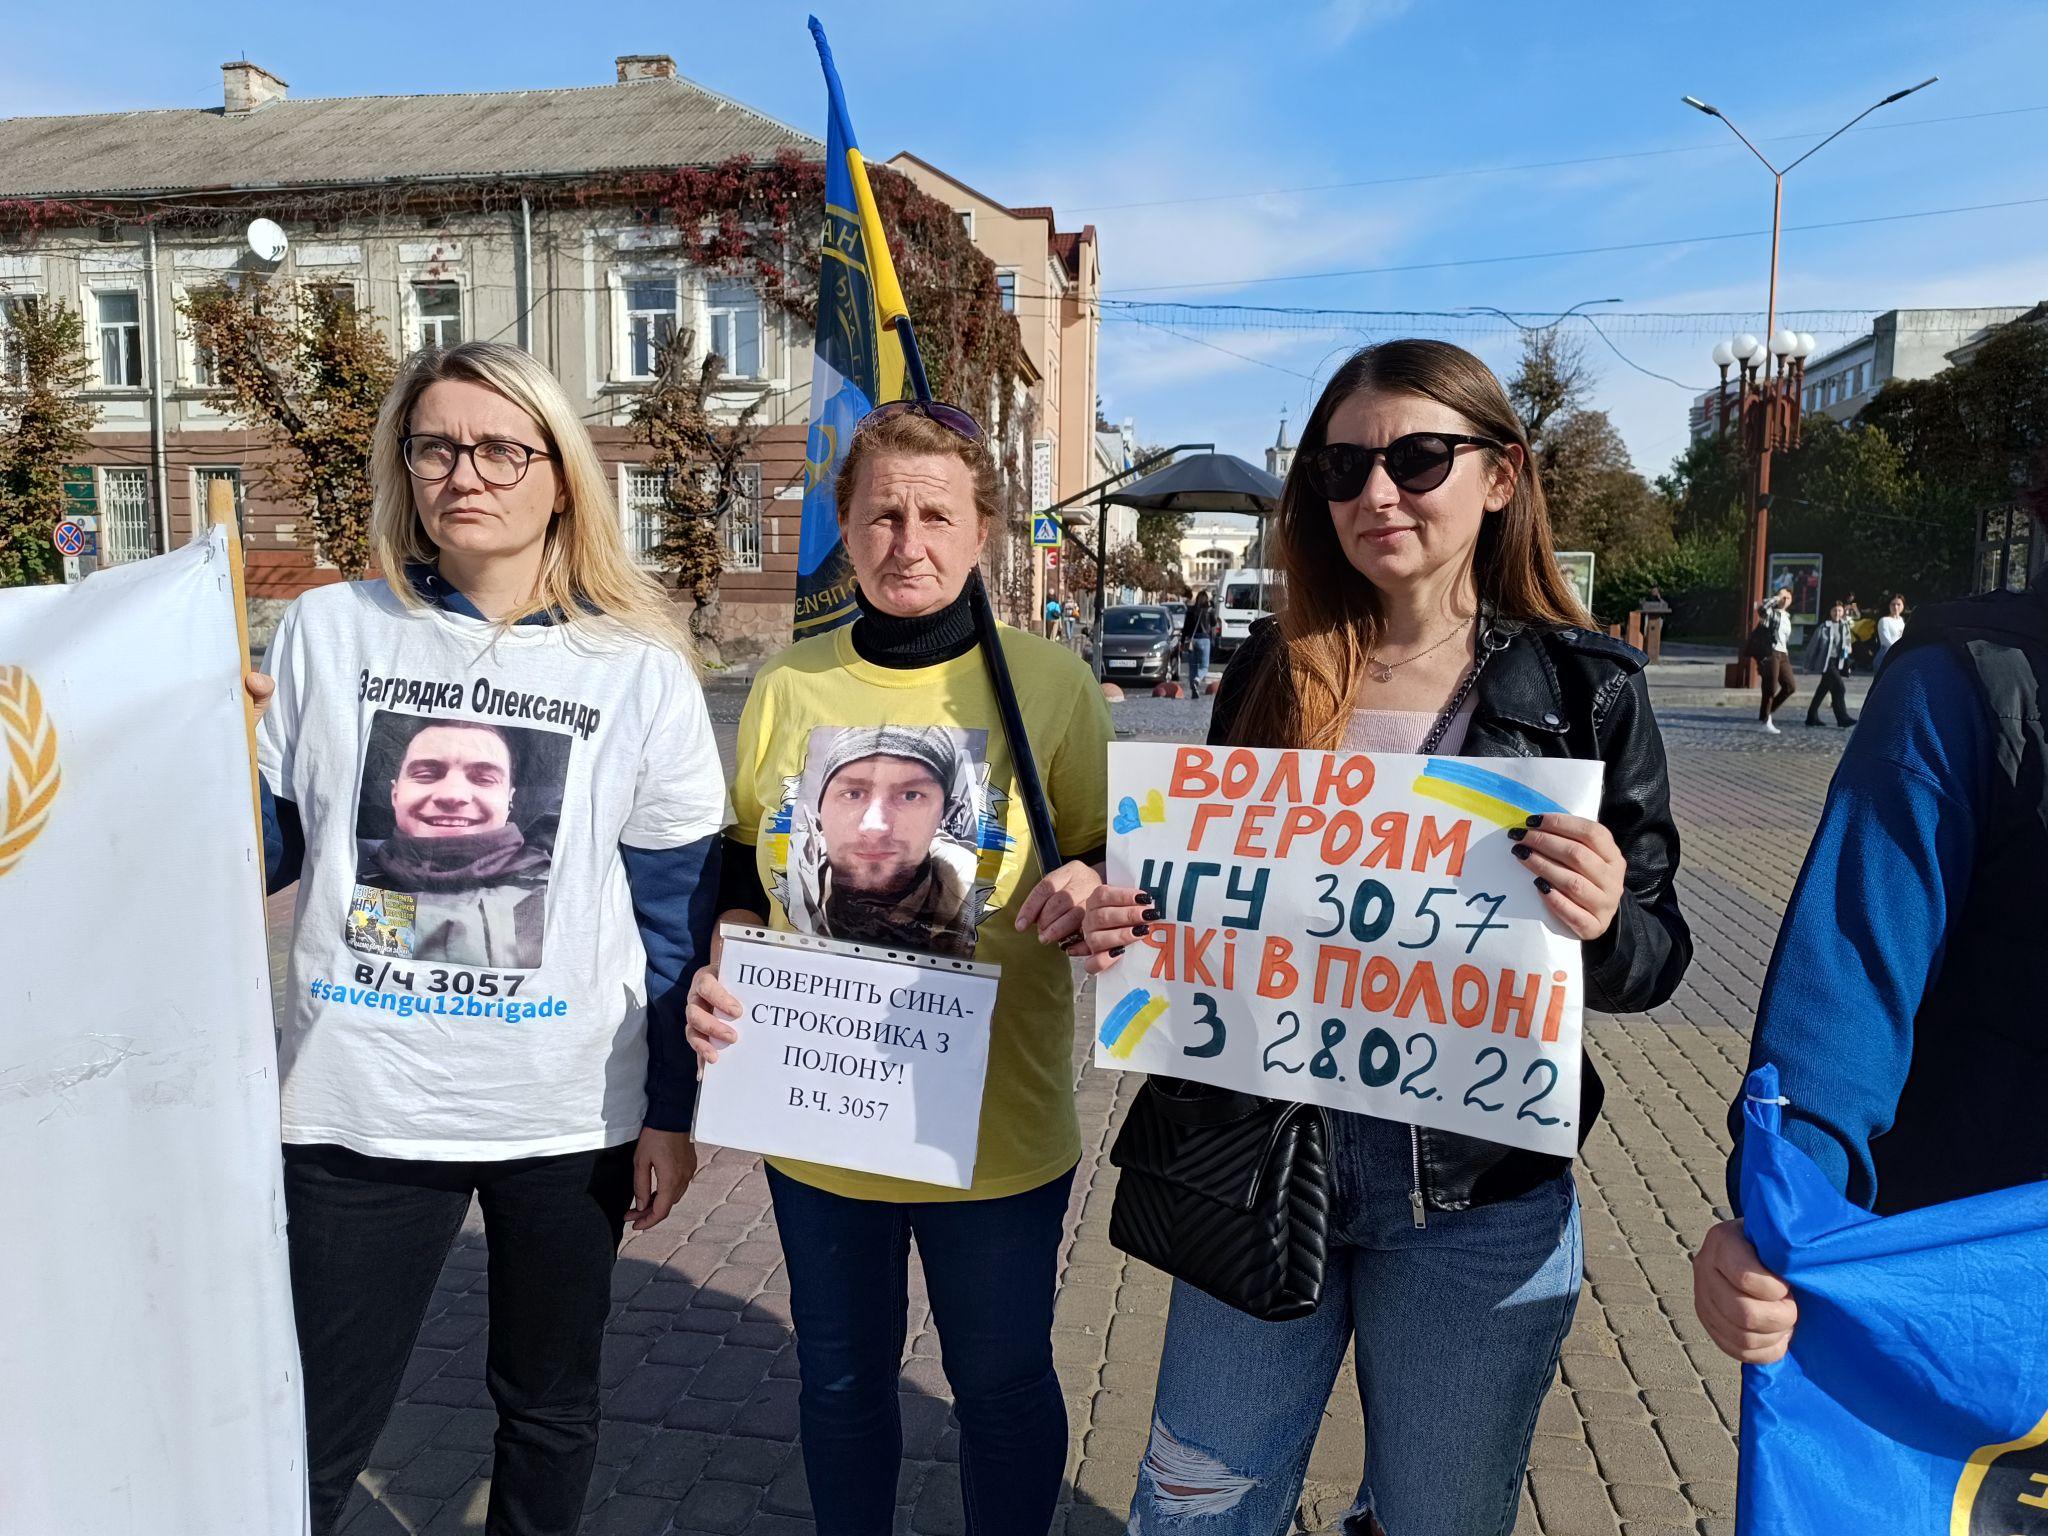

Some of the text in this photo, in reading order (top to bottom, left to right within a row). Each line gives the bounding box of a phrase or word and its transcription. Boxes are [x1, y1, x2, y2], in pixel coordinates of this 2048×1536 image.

[358, 668, 601, 741] Загрядка Олександр
[1168, 747, 1376, 806] ВОЛЮ
[1187, 804, 1472, 876] ГЕРОЯМ
[1306, 873, 1509, 954] 3057
[426, 969, 526, 998] 3057
[737, 962, 975, 1019] ПОВЕРНІТЬ СИНА-
[1256, 935, 1299, 1000] В
[310, 977, 569, 1024] #savengu12brigade
[751, 1002, 929, 1051] СТРОКОВИКА
[782, 1045, 905, 1085] ПОЛОНУ!
[788, 1086, 889, 1122] В.Ч. 3057
